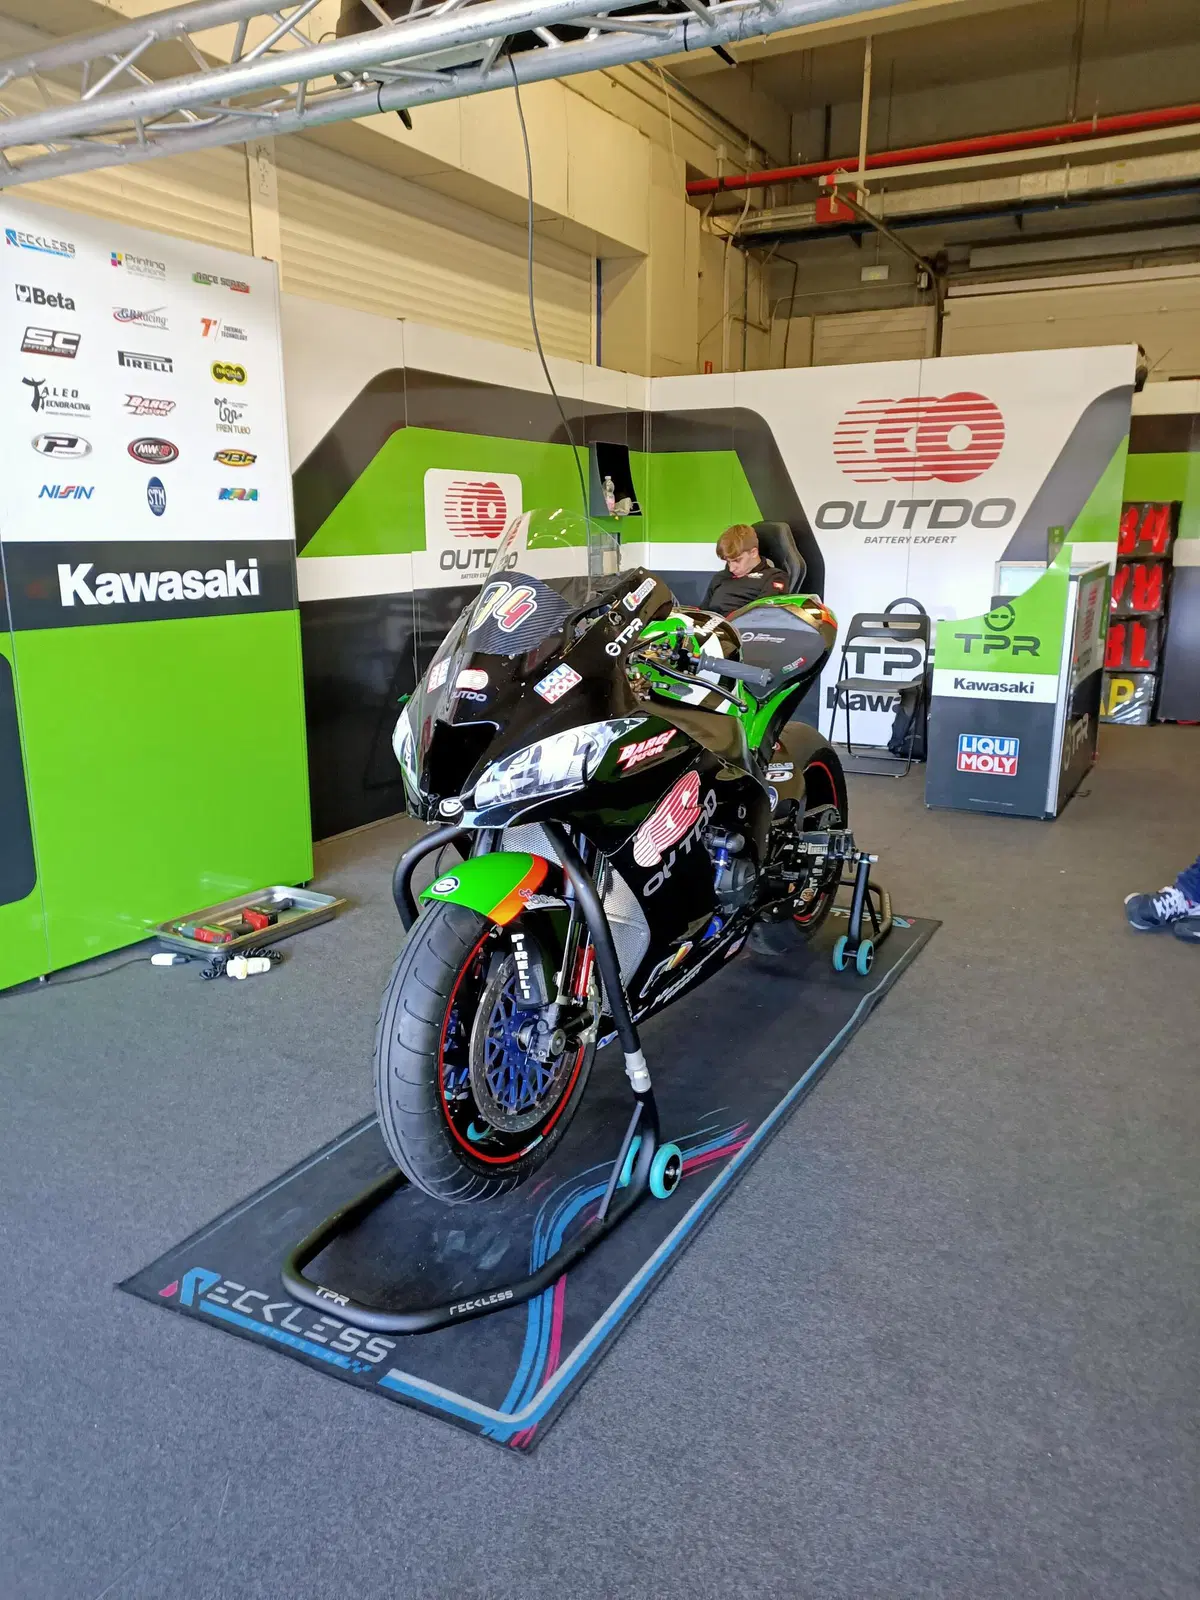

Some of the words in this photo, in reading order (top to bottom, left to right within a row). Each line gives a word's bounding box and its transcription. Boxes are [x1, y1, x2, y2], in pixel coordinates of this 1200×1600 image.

[125, 253, 166, 271] Printing
[32, 286, 76, 311] Beta
[117, 350, 174, 374] PIRELLI
[815, 498, 1017, 530] OUTDO
[864, 536, 911, 544] BATTERY
[914, 536, 957, 544] EXPERT
[57, 558, 260, 607] Kawasaki
[615, 617, 643, 645] TPR
[954, 633, 1041, 657] TPR
[544, 671, 579, 702] MOLY
[953, 677, 1035, 694] Kawasaki
[961, 736, 1016, 757] LIQUI
[960, 753, 1017, 775] MOLY
[510, 933, 530, 999] PIRELLI
[314, 1284, 350, 1307] TPR
